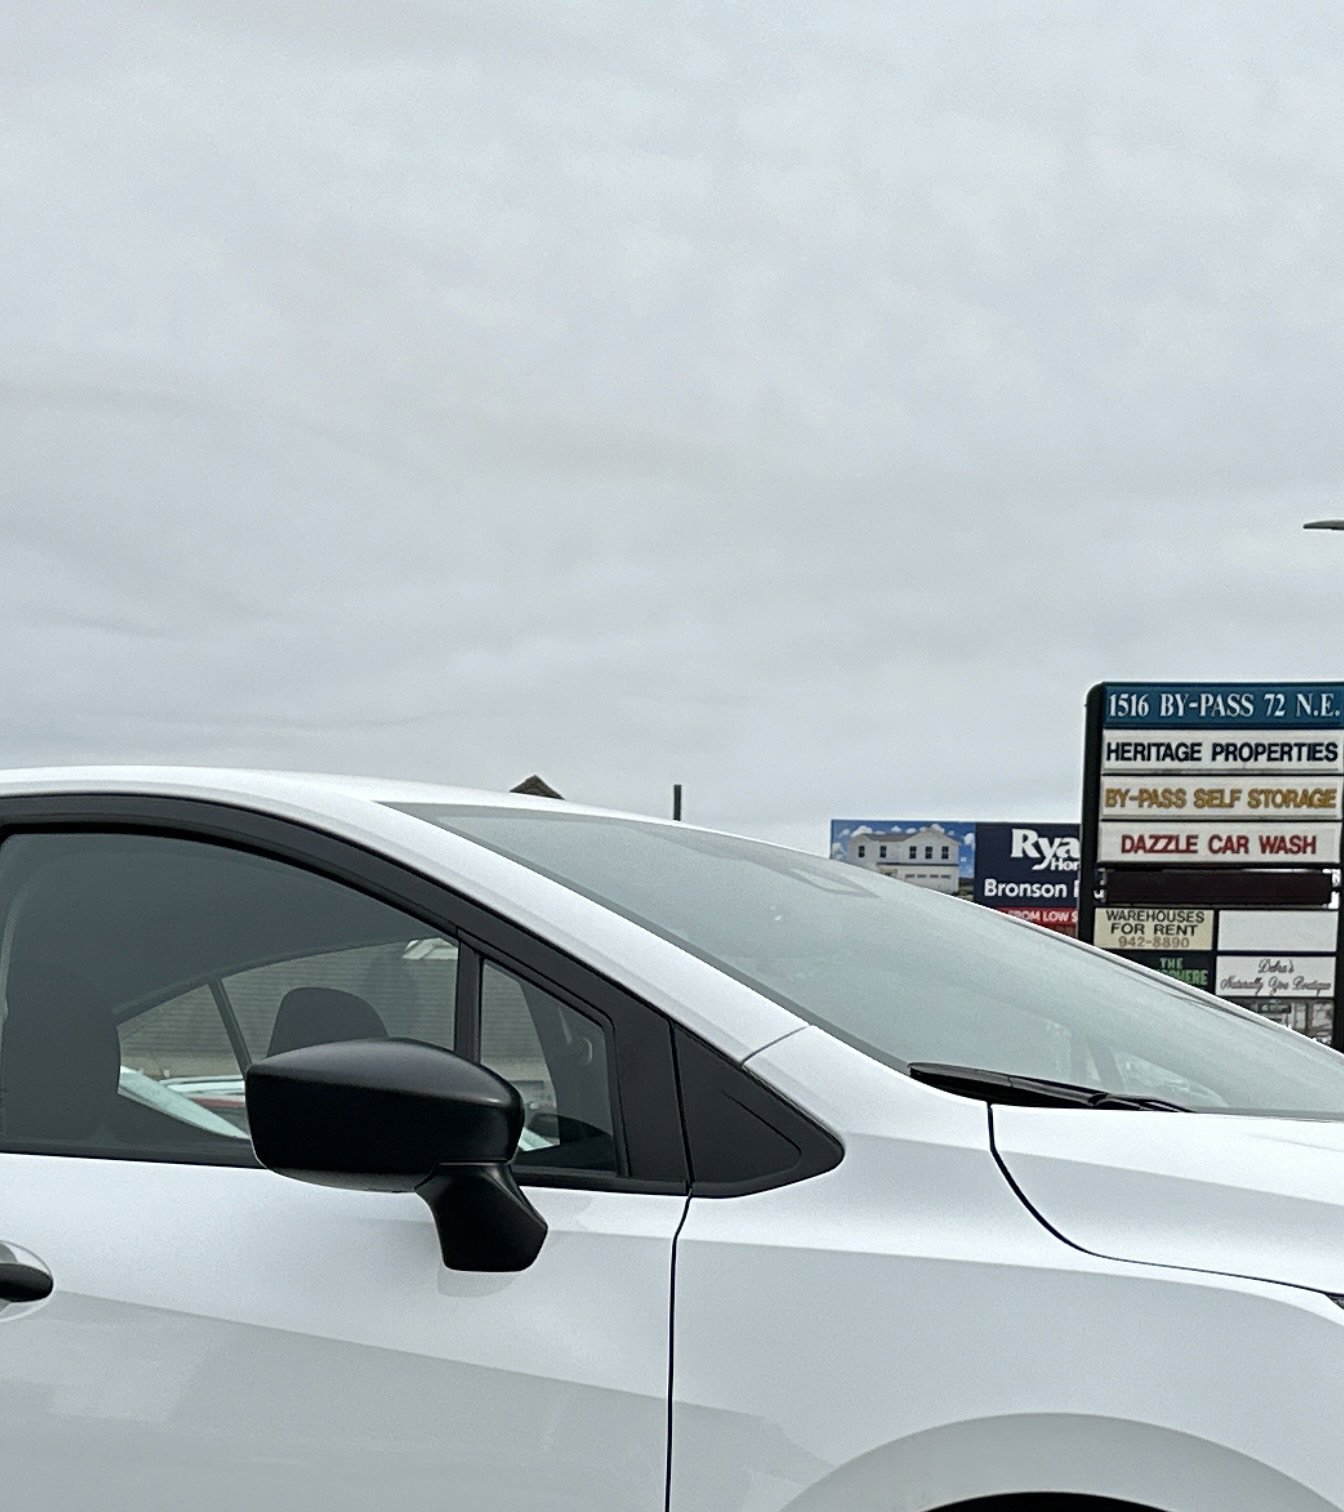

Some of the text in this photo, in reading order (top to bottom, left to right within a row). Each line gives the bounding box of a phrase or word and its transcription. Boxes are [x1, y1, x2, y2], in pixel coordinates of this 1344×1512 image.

[1108, 692, 1341, 718] 1516 BY-PASS 72 N.E.
[1105, 741, 1339, 763] HERITAGE PROPERTIES
[1104, 787, 1337, 810] BY-PASS SELF STORAGE
[1120, 833, 1317, 855] DAZZLE CAR WASH
[984, 878, 1067, 898] Bronson
[1042, 910, 1070, 922] LOW
[1105, 909, 1205, 923] WAREHOUSES
[1110, 923, 1198, 936] FOR RENT
[1159, 957, 1183, 969] THE
